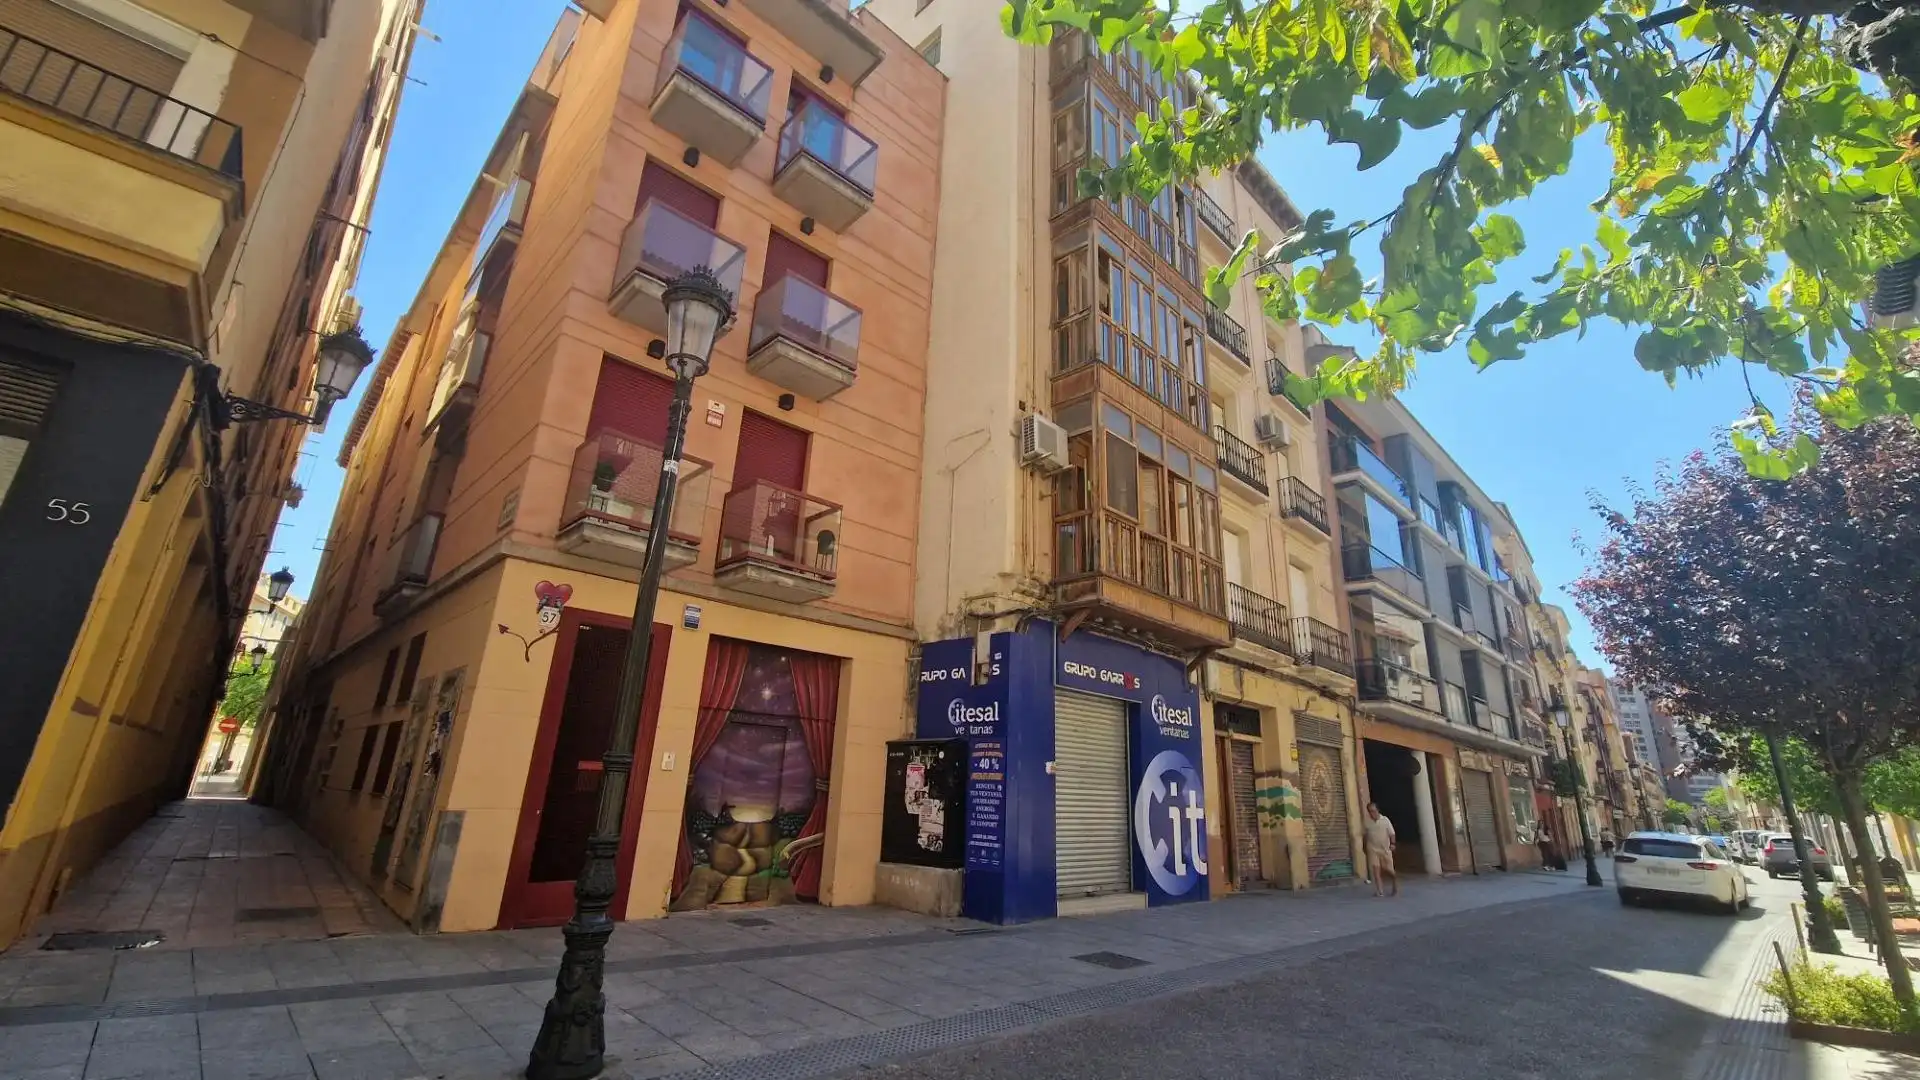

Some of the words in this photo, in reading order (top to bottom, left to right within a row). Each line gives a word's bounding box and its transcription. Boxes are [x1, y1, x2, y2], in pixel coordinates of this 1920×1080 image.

[47, 498, 90, 525] 55
[541, 611, 557, 624] 57
[921, 669, 947, 682] RUPO
[1064, 661, 1096, 679] GRUPO
[948, 698, 999, 726] Citesal
[1151, 694, 1192, 727] Citesal
[954, 725, 993, 735] vetanas
[1159, 725, 1190, 739] ventanas
